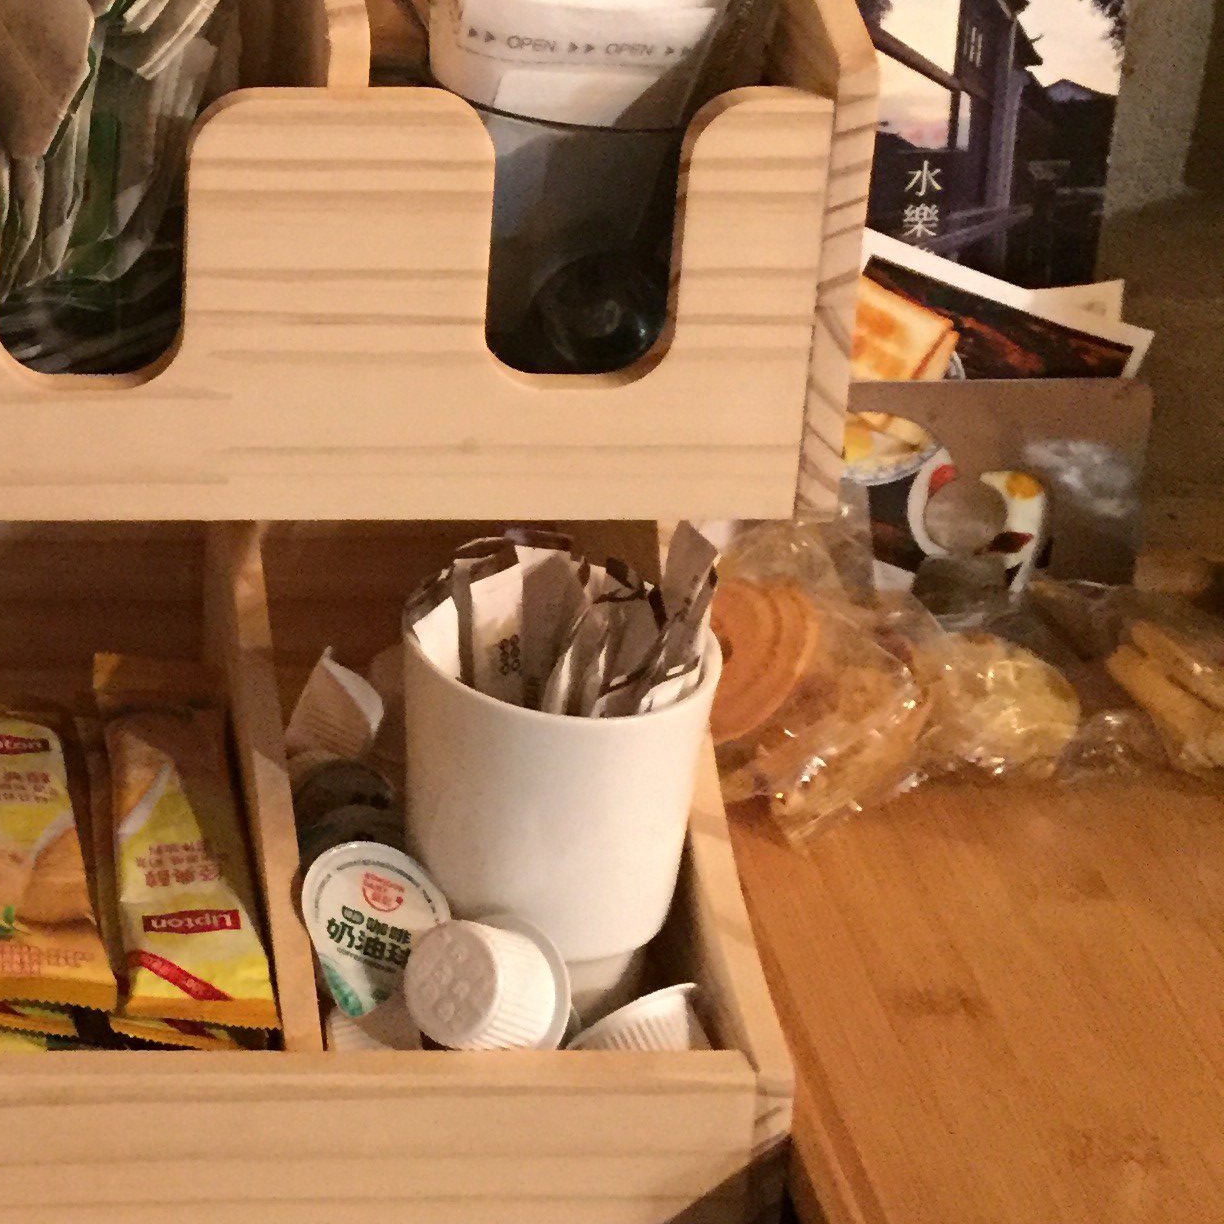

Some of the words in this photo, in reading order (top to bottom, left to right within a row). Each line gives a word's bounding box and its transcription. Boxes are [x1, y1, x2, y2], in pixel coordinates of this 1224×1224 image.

[507, 35, 558, 53] OPEN
[605, 42, 655, 56] OPEN
[903, 160, 942, 237] 水樂
[151, 913, 232, 929] Lipton
